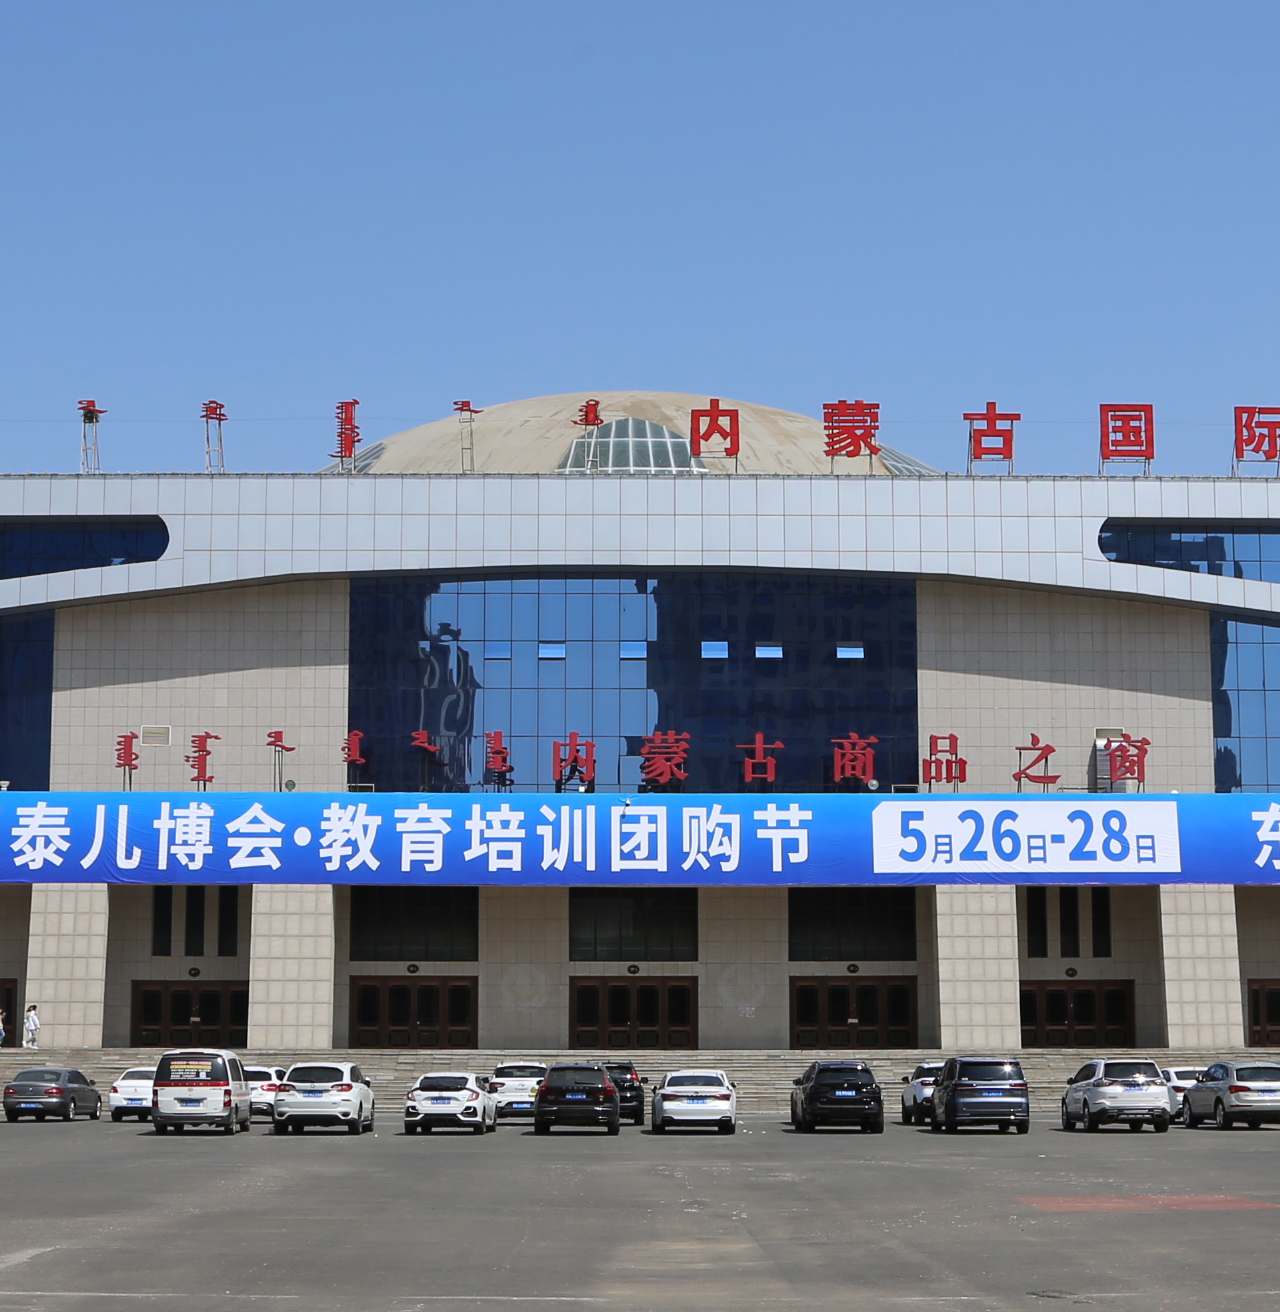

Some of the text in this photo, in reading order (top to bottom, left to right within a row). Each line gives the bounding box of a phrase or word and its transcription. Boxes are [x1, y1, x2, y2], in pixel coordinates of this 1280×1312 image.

[552, 731, 1151, 784] 内蒙古商品之窗
[898, 809, 1157, 863] 5月26日-28日
